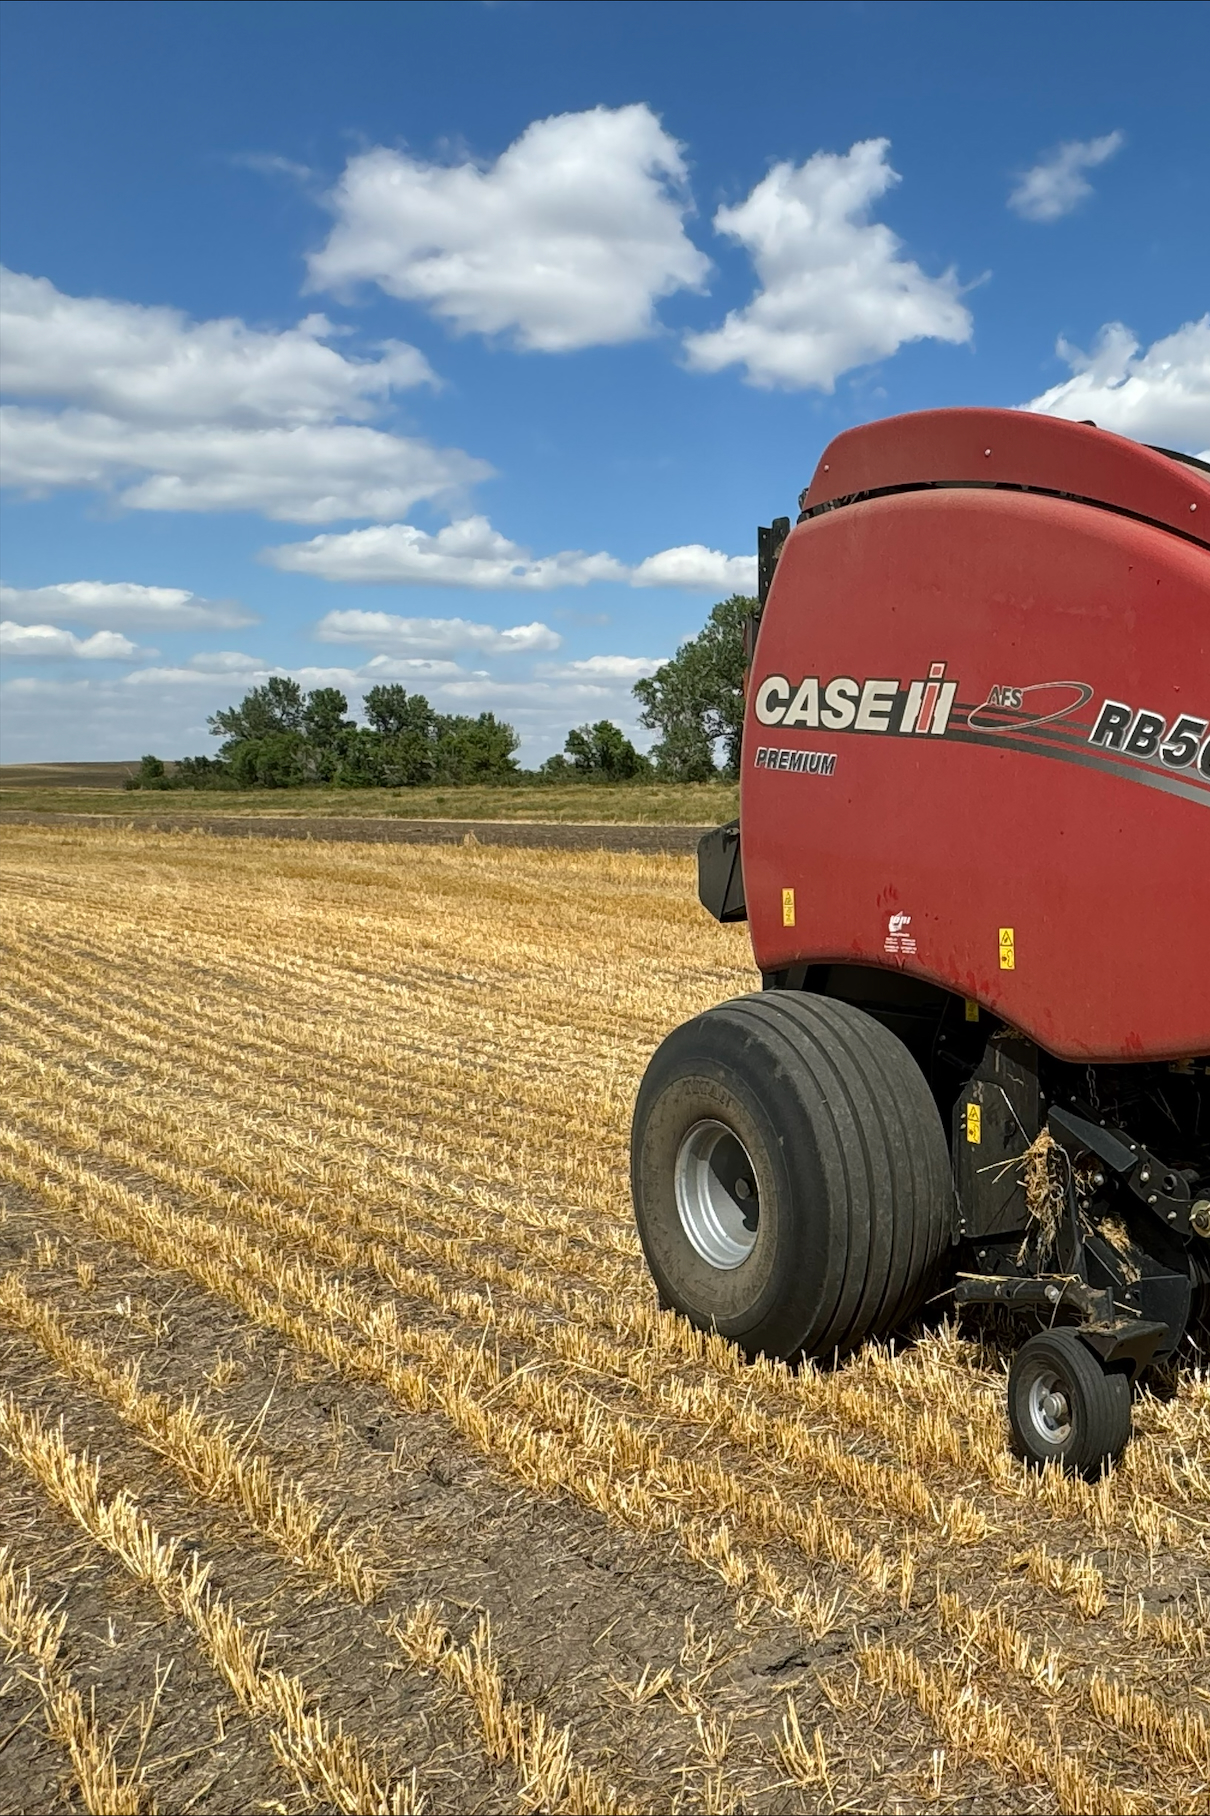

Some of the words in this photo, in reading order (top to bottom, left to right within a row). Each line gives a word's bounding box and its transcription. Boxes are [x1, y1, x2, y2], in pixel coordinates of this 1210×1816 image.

[756, 676, 899, 731] CASE
[986, 685, 1024, 709] AFS
[754, 746, 838, 776] PREMIUM
